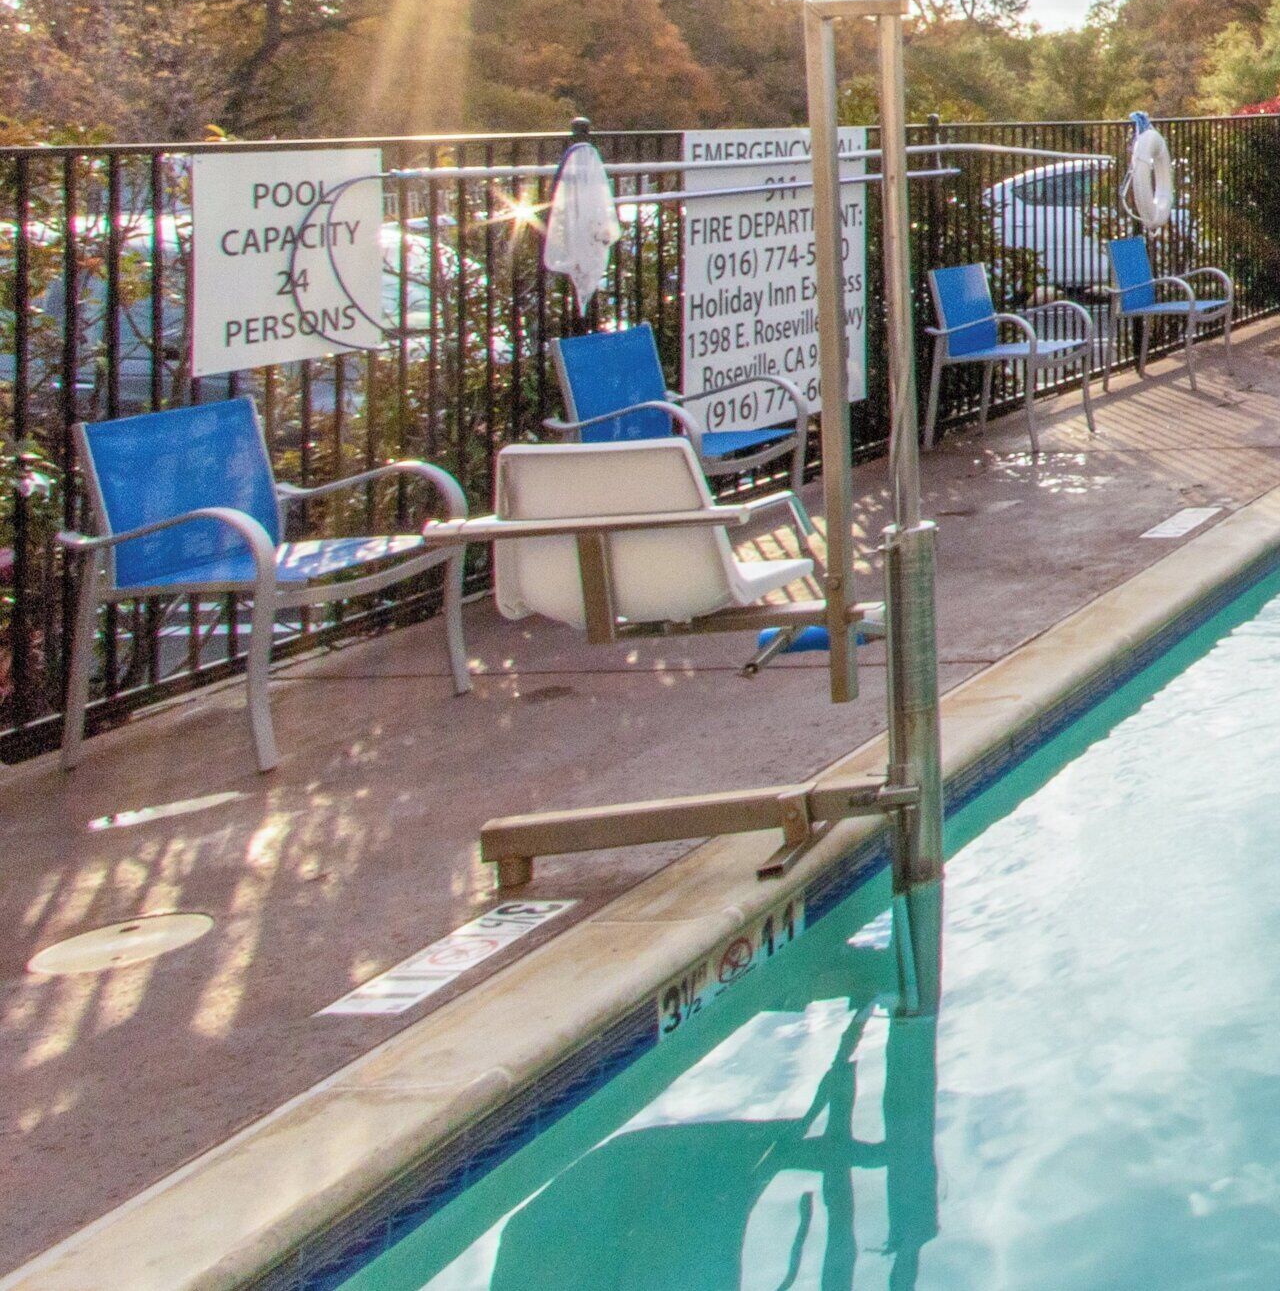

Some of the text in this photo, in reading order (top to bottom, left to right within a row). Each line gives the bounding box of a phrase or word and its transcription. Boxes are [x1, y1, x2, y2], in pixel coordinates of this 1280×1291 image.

[254, 181, 333, 209] POOL
[765, 176, 798, 202] 911
[221, 220, 360, 256] CAPACITY
[690, 215, 733, 246] FIRE
[707, 238, 850, 285] (916) 774-50
[276, 269, 310, 295] 24
[690, 285, 764, 322] Holiday
[769, 282, 796, 307] Inn
[225, 305, 357, 347] PERSONS
[688, 326, 731, 358] 1398
[736, 322, 749, 348] E.
[754, 309, 820, 346] Roseville
[784, 346, 805, 373] CA
[706, 390, 758, 432] (916)
